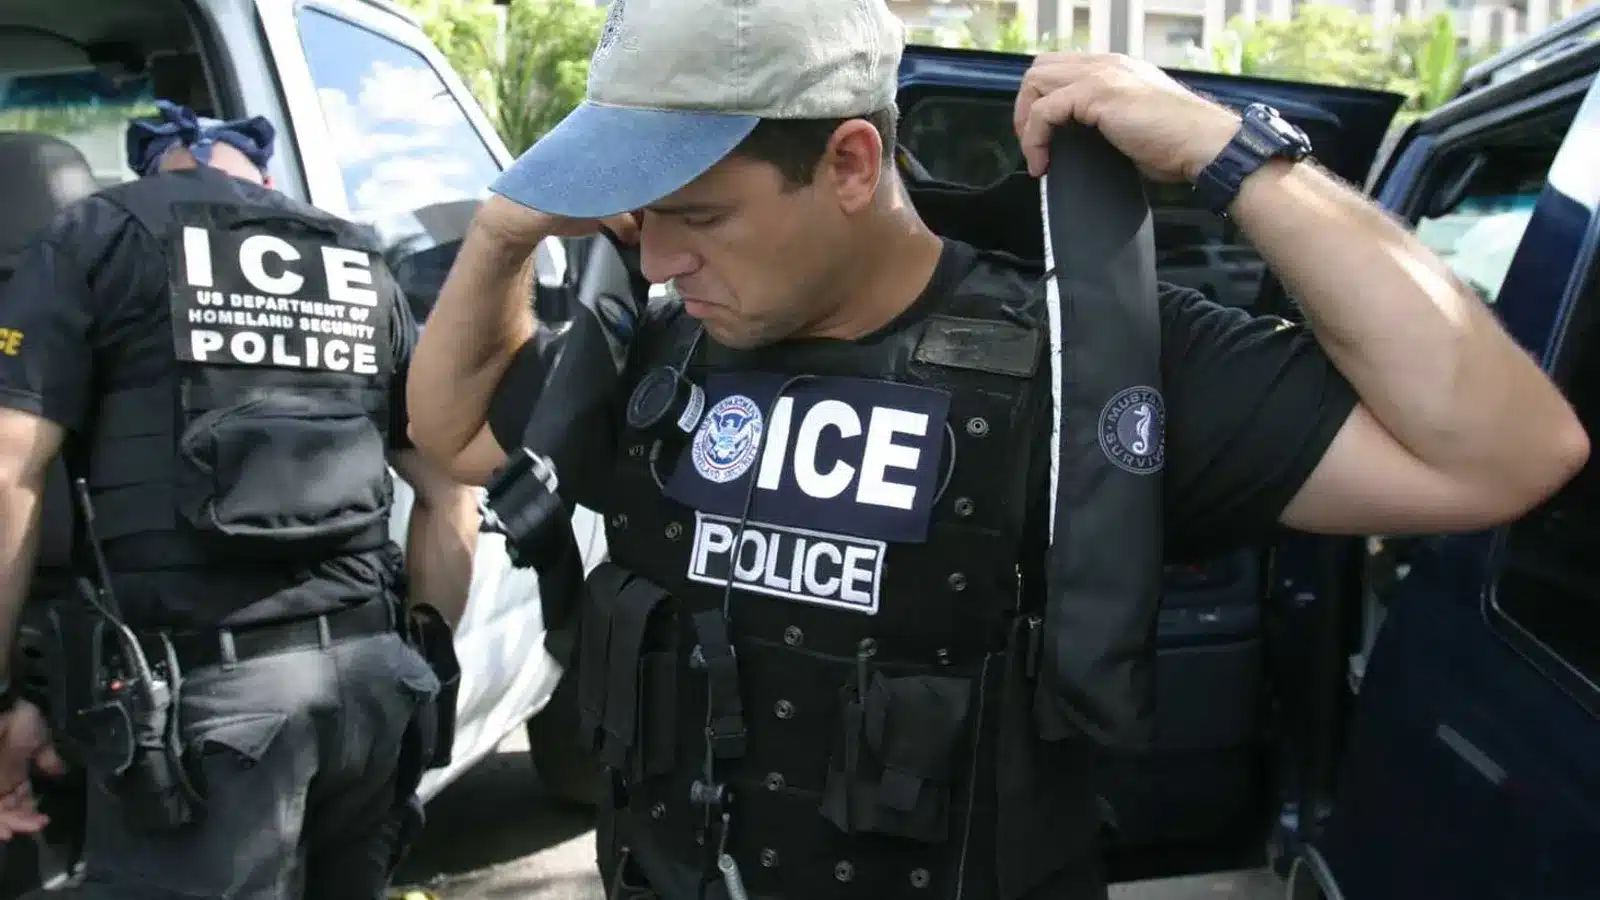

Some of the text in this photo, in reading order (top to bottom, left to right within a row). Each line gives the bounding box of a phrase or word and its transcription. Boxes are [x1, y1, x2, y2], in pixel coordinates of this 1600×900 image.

[183, 226, 378, 307] ICE
[188, 308, 375, 339] HOMELAND SECURITY
[196, 290, 370, 323] US DEPARTMENT OF
[190, 329, 379, 375] POLICE
[1107, 392, 1164, 424] MUSTA
[756, 396, 930, 511] ICE
[694, 521, 878, 605] POLICE
